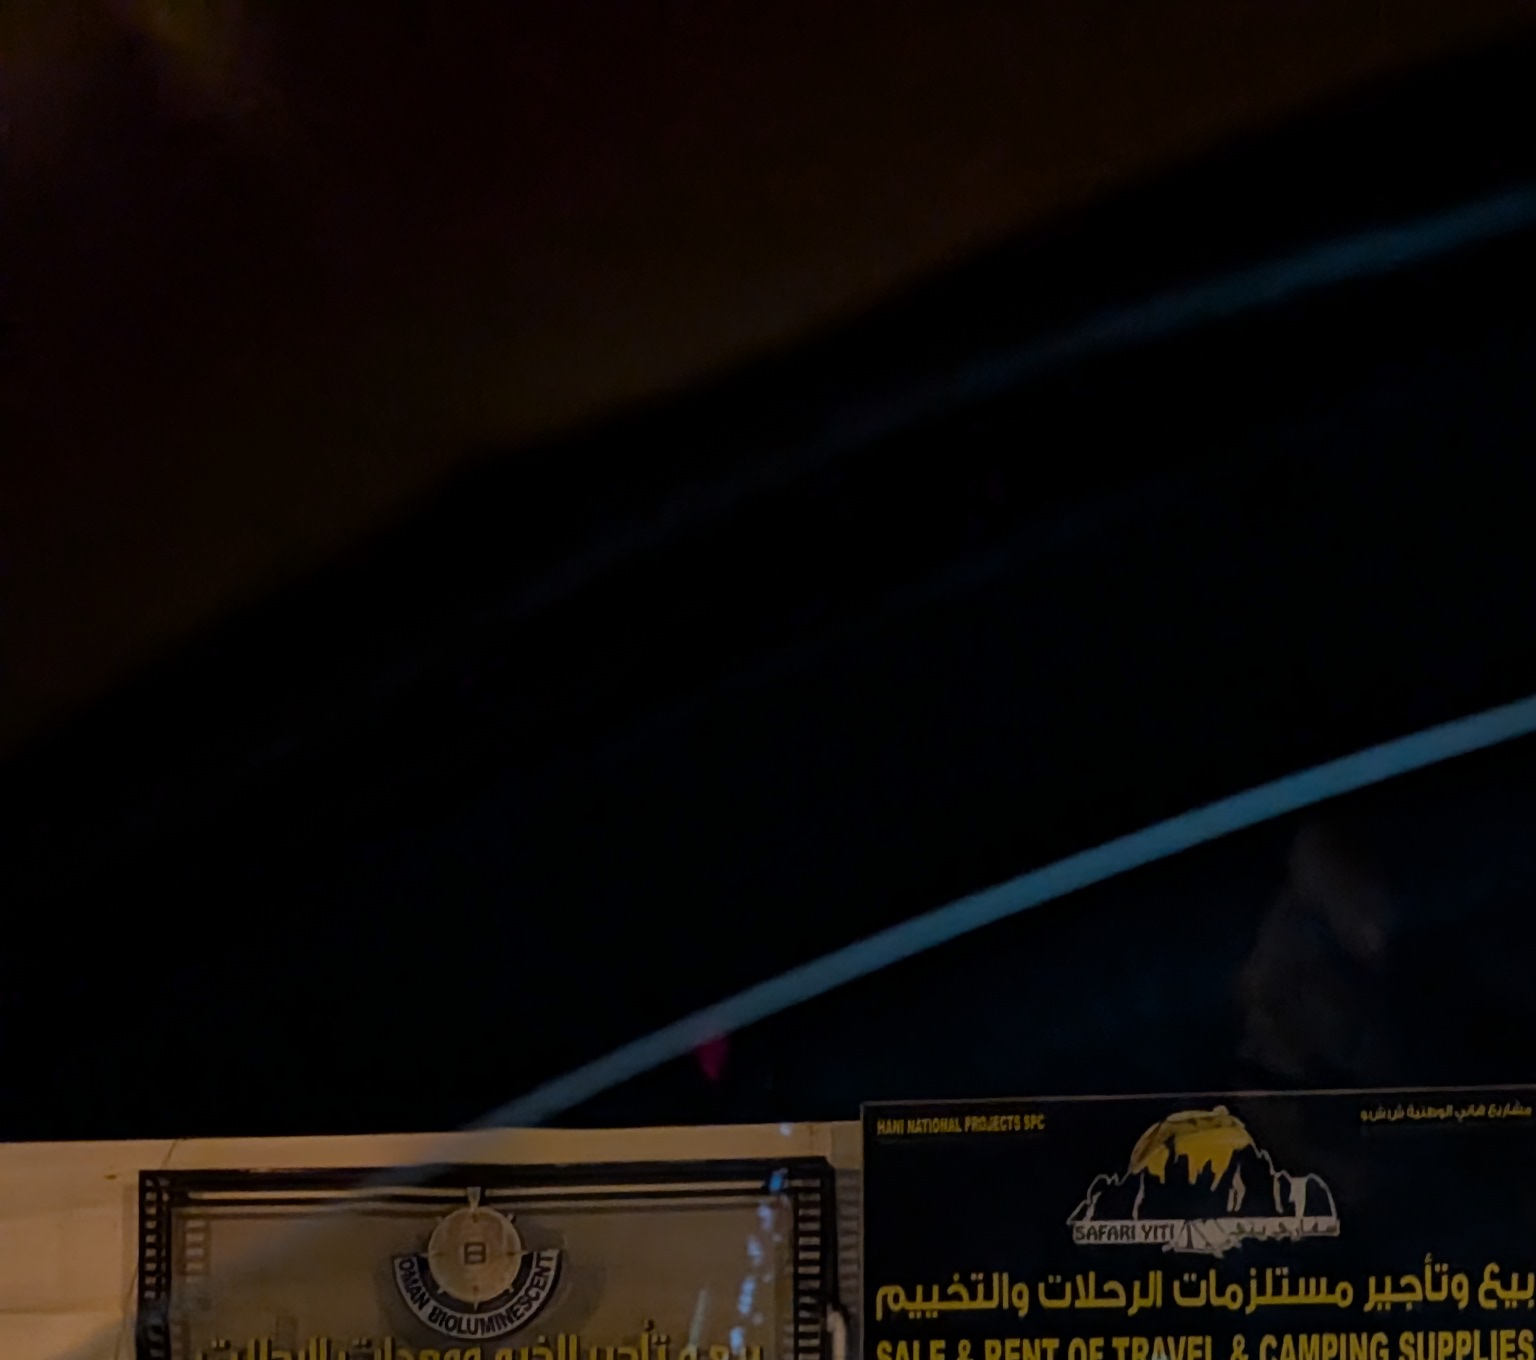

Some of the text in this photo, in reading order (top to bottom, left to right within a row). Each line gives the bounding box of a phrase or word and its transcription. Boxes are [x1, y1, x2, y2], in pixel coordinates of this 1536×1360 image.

[877, 1113, 1046, 1135] HANI NATIONAL PROJECTS SPC
[1074, 1224, 1174, 1241] SAFARI YITI
[428, 1250, 554, 1336] BIOLUMINESCENT
[875, 1253, 1536, 1321] بيع وتأجير مستلزمات الرحلات والتخييم
